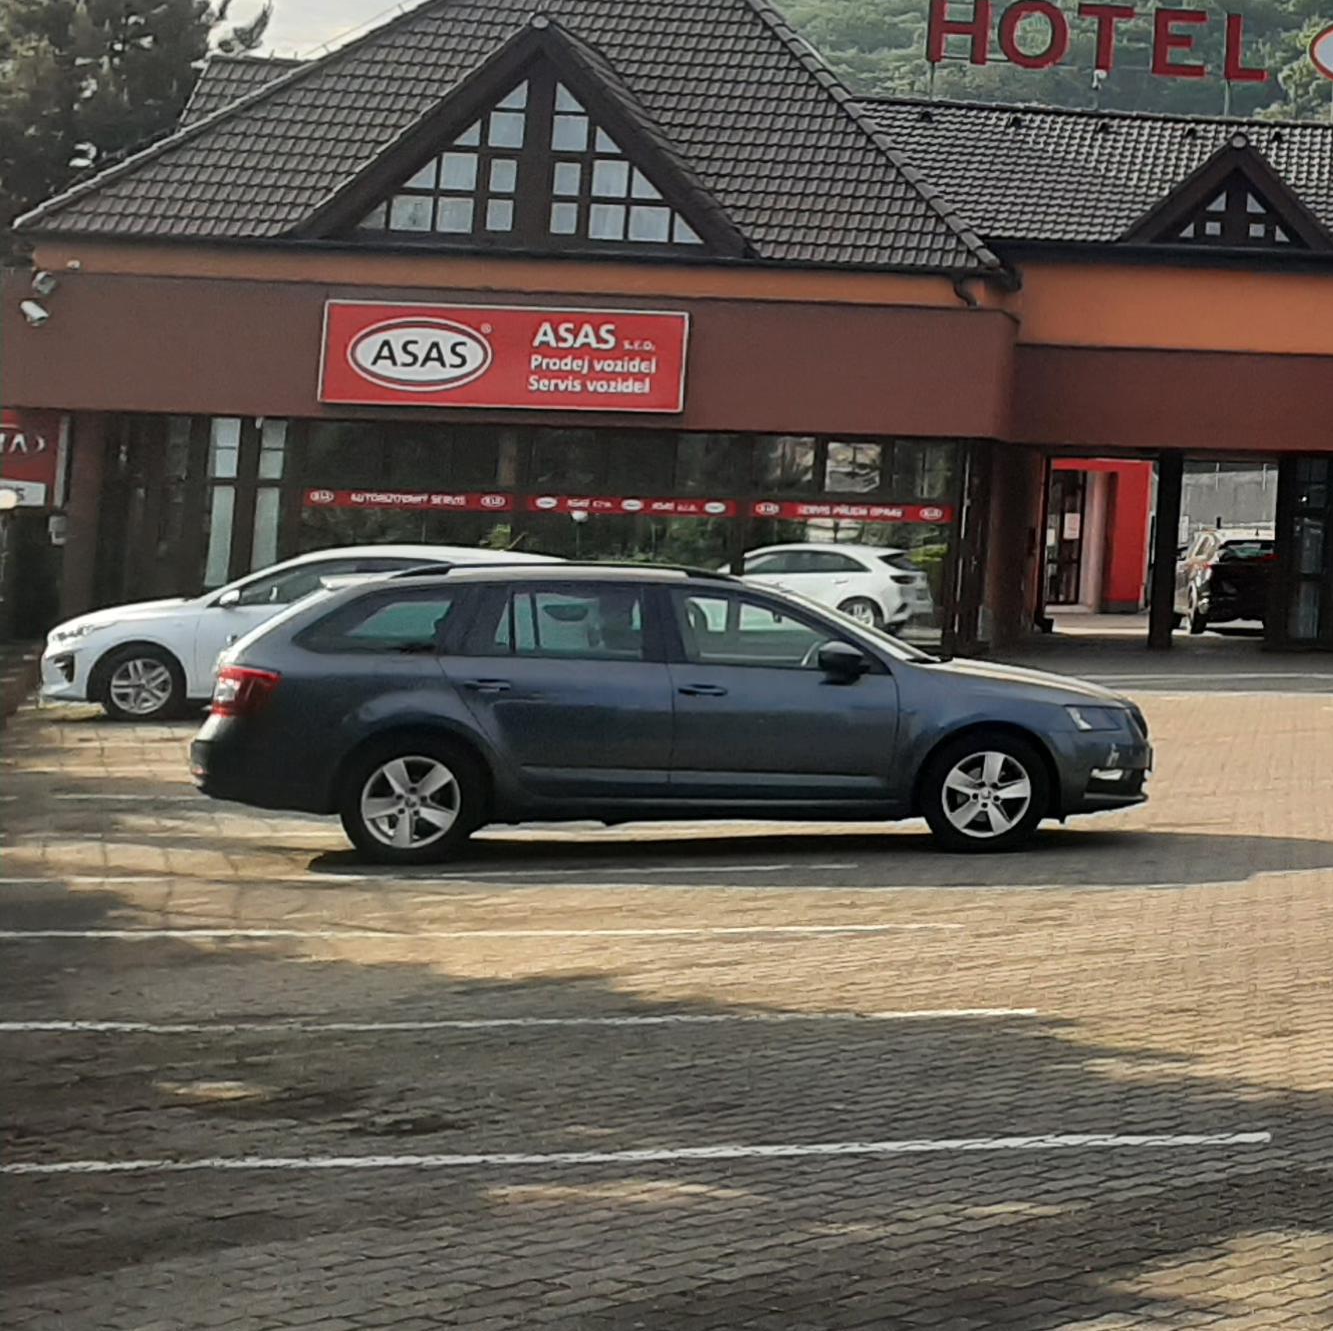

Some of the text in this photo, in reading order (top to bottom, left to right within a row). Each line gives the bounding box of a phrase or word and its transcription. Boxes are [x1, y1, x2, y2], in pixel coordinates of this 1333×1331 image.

[532, 321, 617, 351] ASAS
[369, 339, 469, 369] ASAS
[530, 354, 657, 375] Prodej vozidel
[527, 374, 651, 395] Servis vozidel
